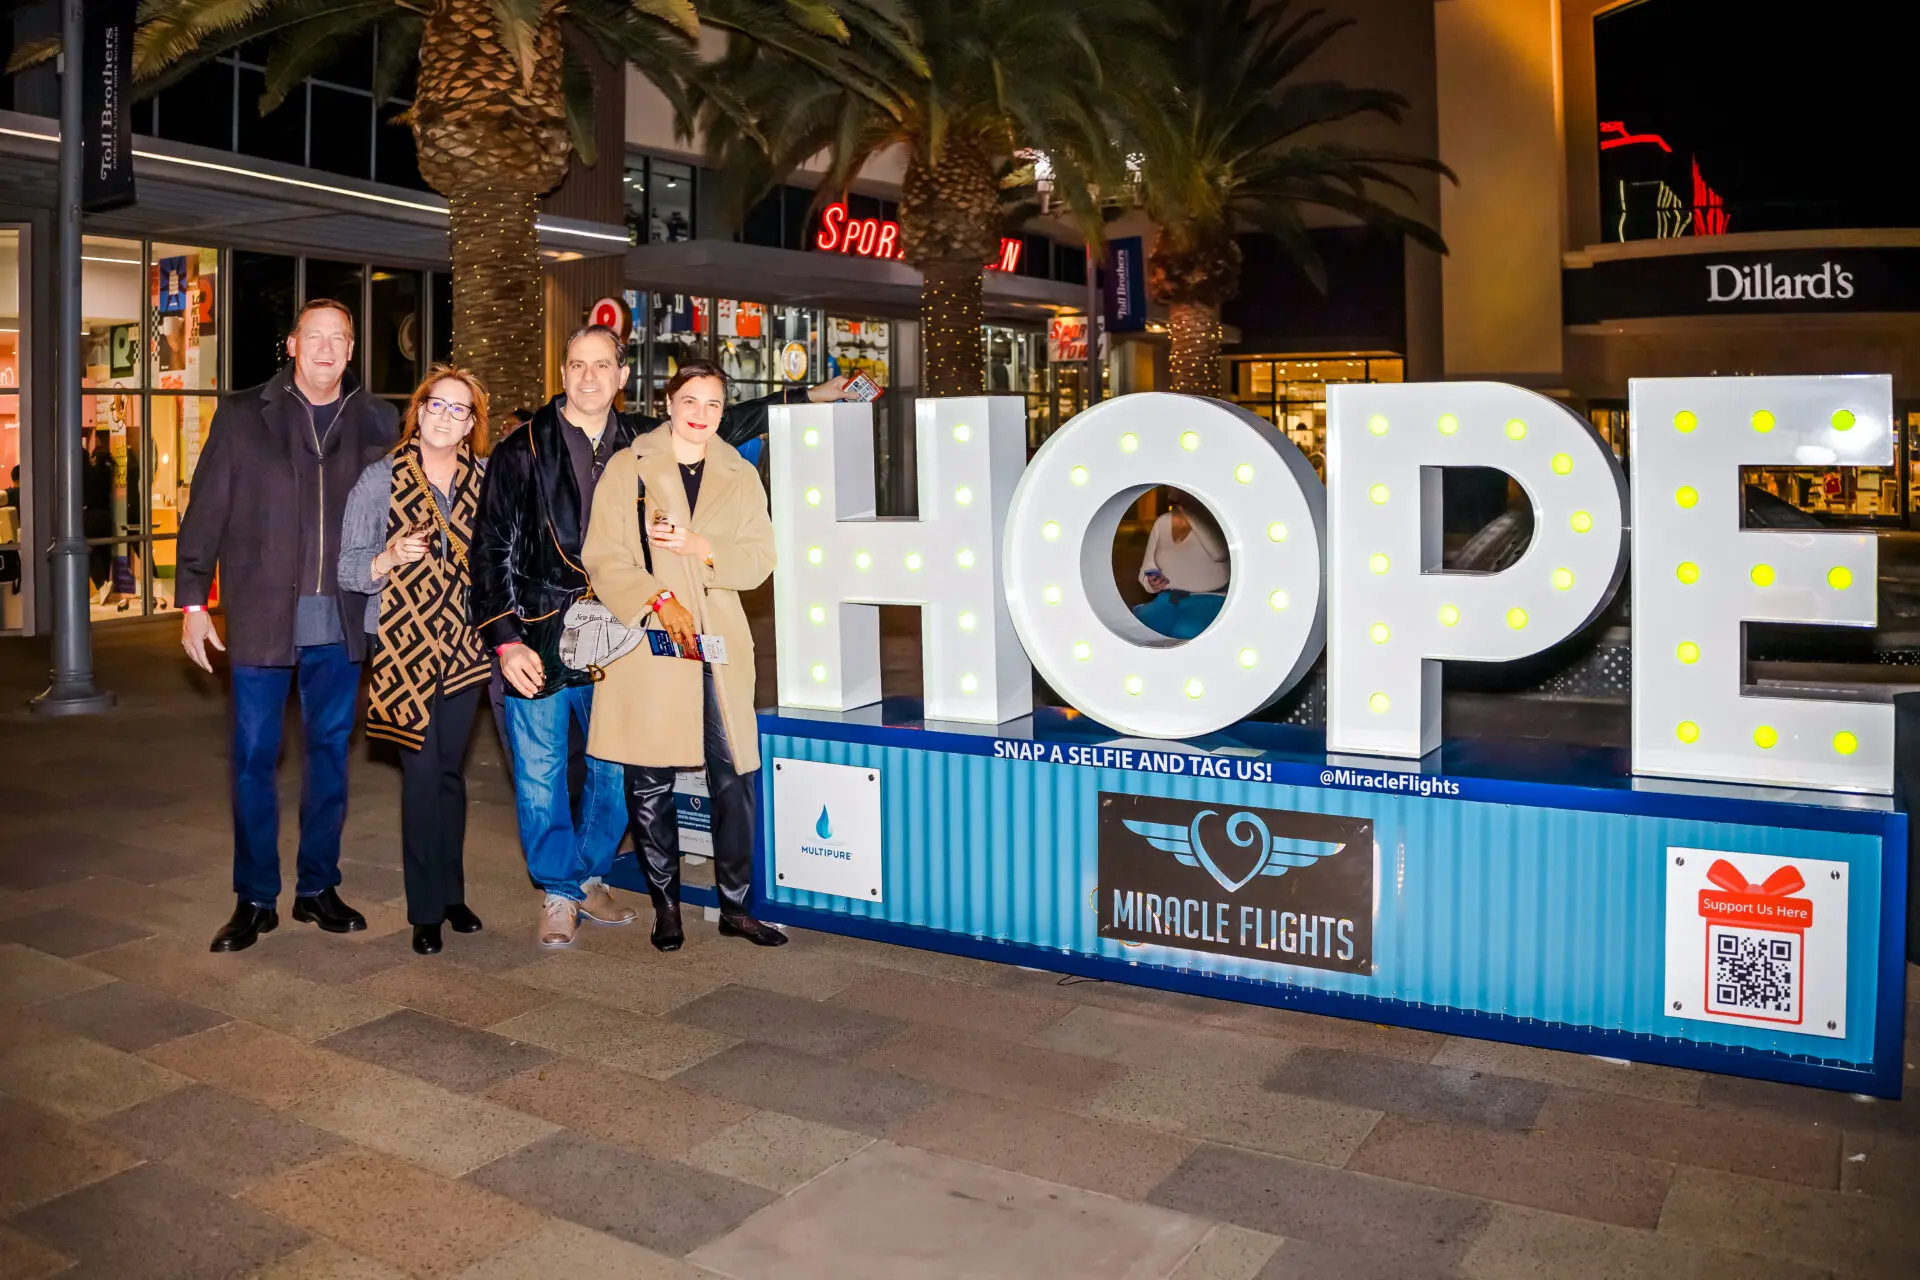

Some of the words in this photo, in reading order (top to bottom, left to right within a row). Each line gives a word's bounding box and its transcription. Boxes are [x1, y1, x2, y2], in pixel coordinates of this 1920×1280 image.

[101, 27, 114, 129] Brothers
[100, 133, 113, 181] Toll
[1115, 249, 1126, 296] Brothers
[1705, 261, 1854, 302] Dillard's
[1116, 297, 1128, 320] Toll
[768, 373, 1896, 796] HOPE
[993, 740, 1045, 763] SNAP
[1049, 744, 1064, 764] A
[1068, 746, 1133, 770] SELFIE
[1138, 752, 1185, 775] AND
[1189, 756, 1231, 779] TAG
[1236, 759, 1273, 783] US!
[1319, 767, 1460, 797] @MiracleFlights
[1112, 889, 1230, 944] MIRACLE
[1240, 907, 1355, 962] FLIGHTS
[1703, 898, 1754, 914] Support
[1757, 902, 1773, 916] Us
[1777, 905, 1808, 919] Here
